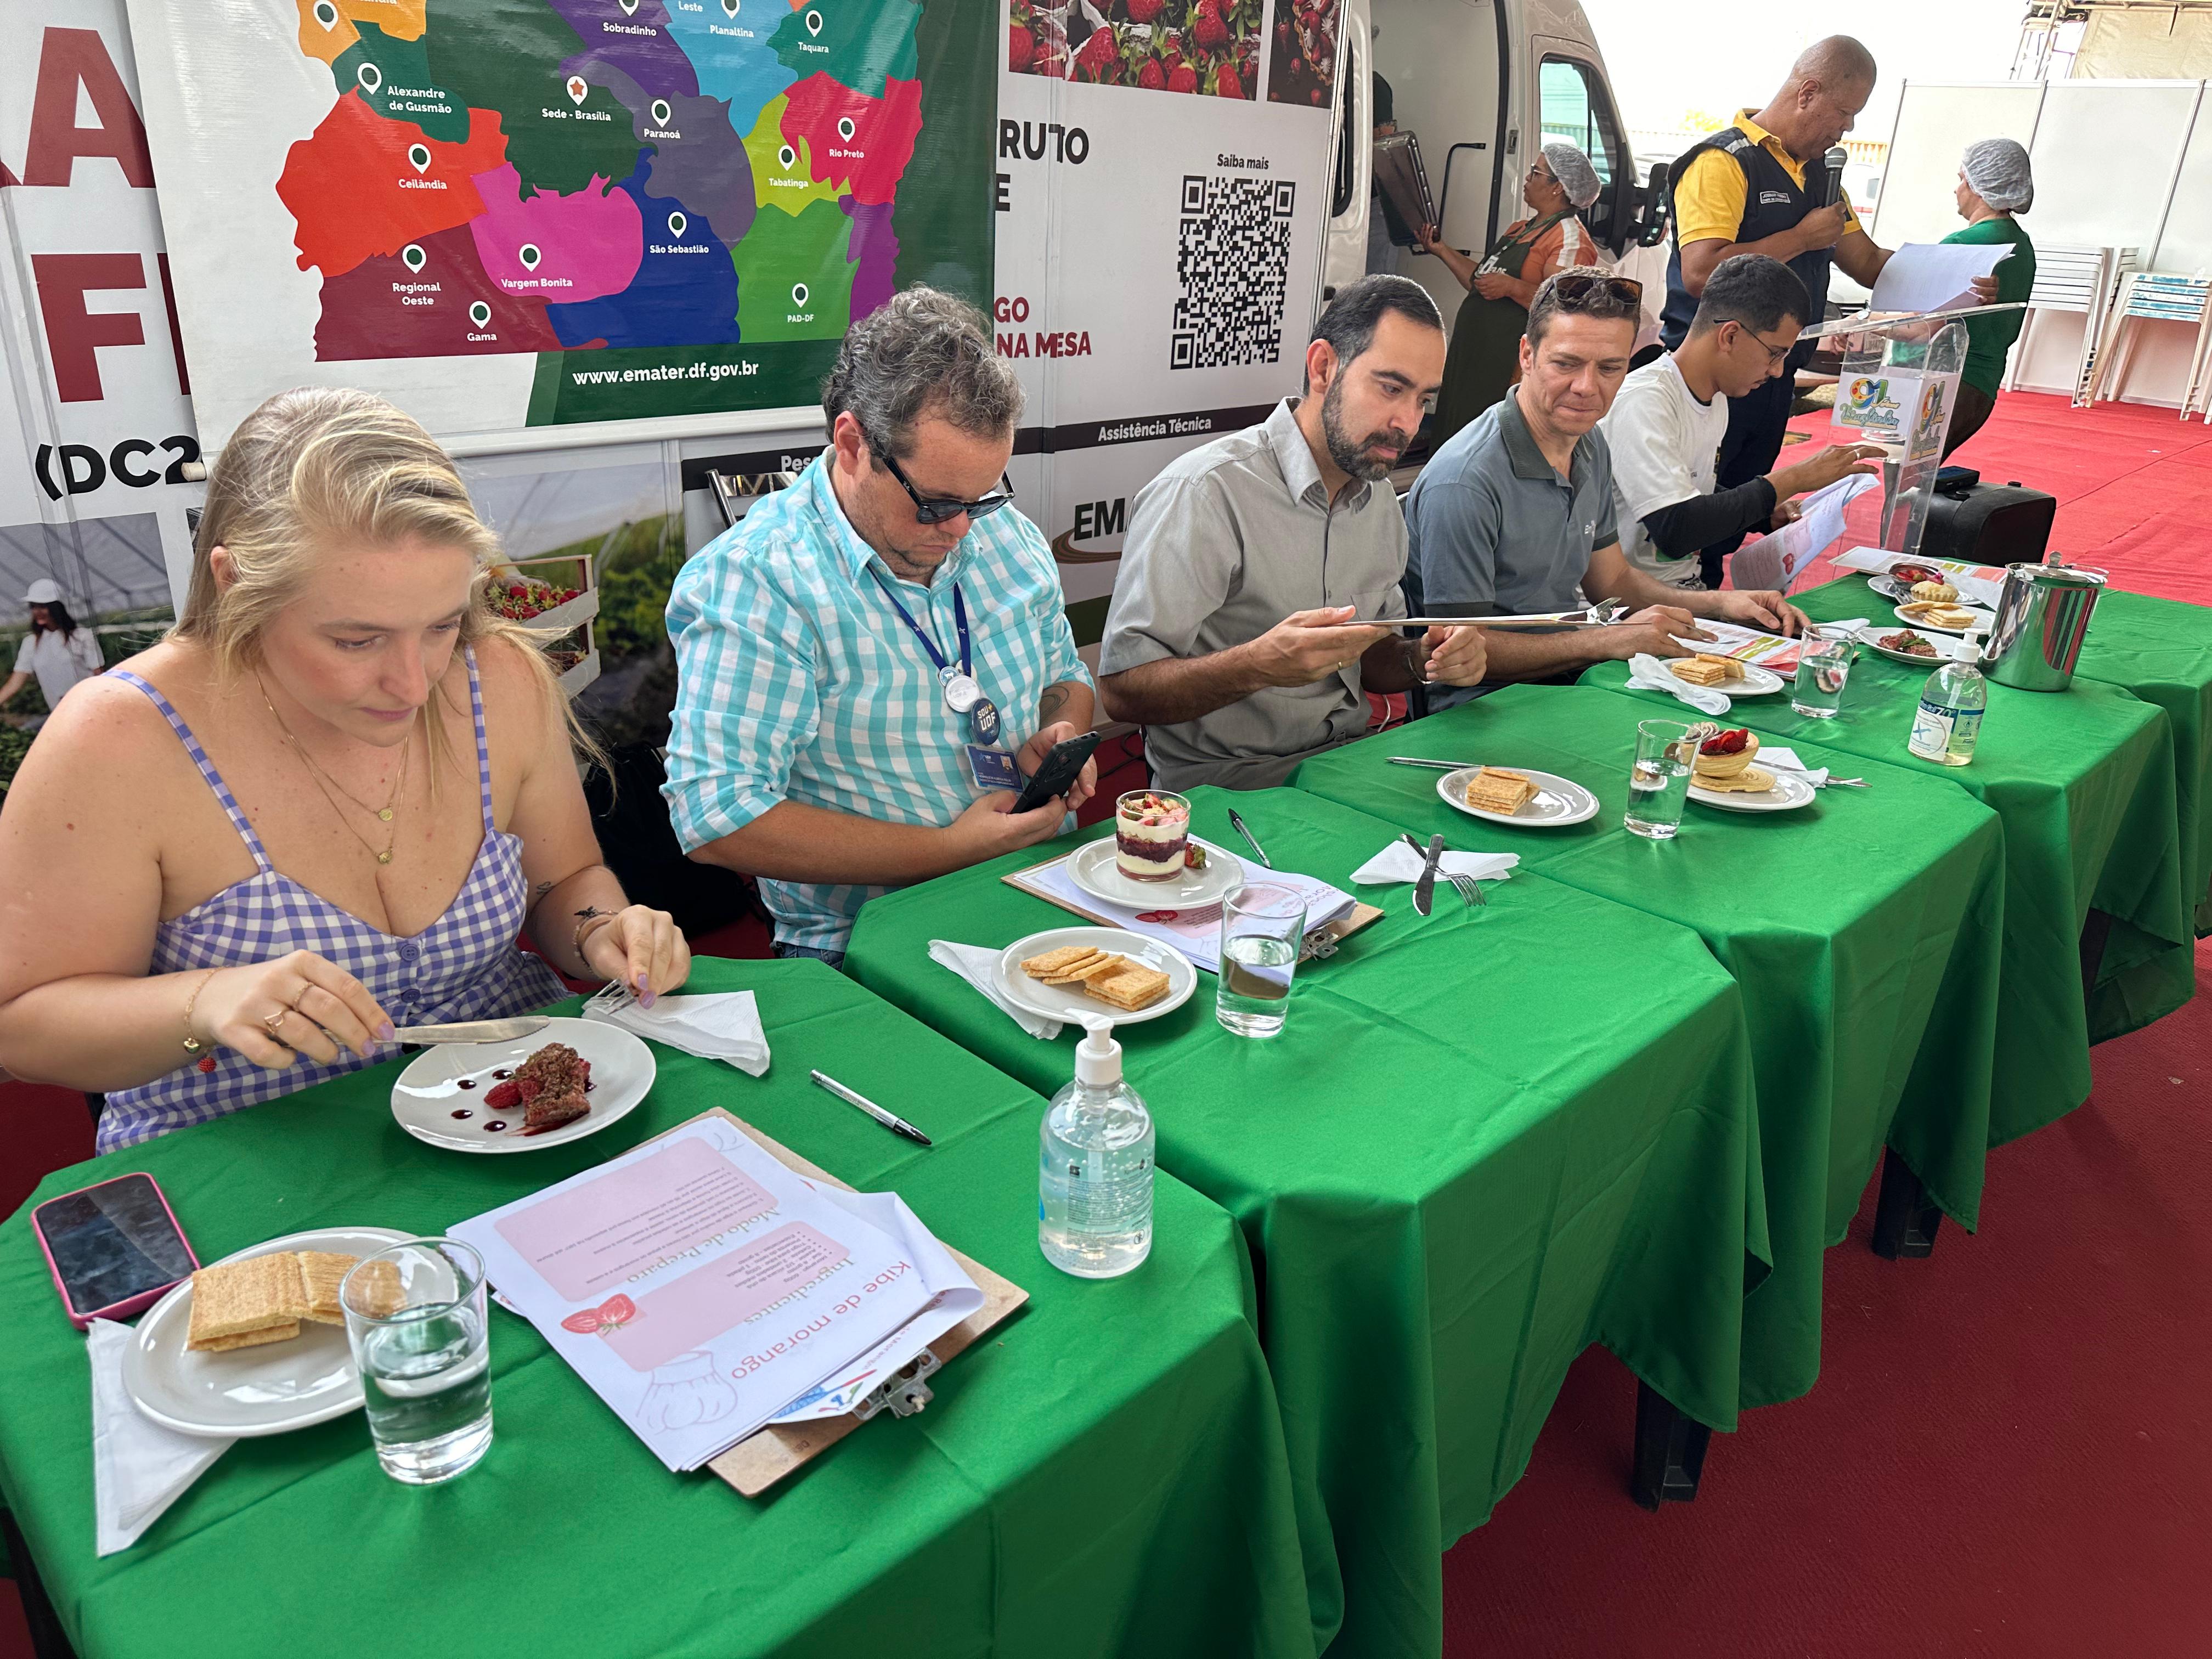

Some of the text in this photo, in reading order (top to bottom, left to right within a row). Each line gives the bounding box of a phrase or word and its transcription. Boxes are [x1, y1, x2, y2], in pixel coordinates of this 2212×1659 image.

[678, 1, 703, 12] Leste
[603, 22, 657, 36] Sobradinho
[710, 25, 754, 38] Planaltina
[798, 42, 829, 53] Taquara
[387, 86, 445, 99] Alexandre
[389, 101, 452, 114] de Gusmão
[542, 108, 567, 119] Sede
[575, 110, 611, 122] Brasília
[644, 128, 681, 139] Paranoá
[829, 149, 865, 159] Rio Preto
[1217, 154, 1269, 170] Saiba mais
[398, 179, 447, 190] Ceilândia
[769, 178, 809, 189] Tabatinga
[650, 245, 709, 253] São Sebastião
[392, 282, 441, 293] Regional
[501, 278, 573, 290] Vargem Bonita
[402, 296, 434, 306] Oeste
[787, 314, 814, 323] PAD-DF
[467, 332, 497, 341] Gama
[997, 331, 1092, 358] NA MESA
[572, 360, 759, 386] www.emater.df.gov.br
[1850, 378, 1888, 409] 91
[1098, 416, 1212, 441] Assistência Técnica
[980, 712, 996, 732] UDF
[727, 1207, 781, 1234] Modo
[702, 1233, 724, 1246] de
[627, 1246, 702, 1283] Preparo
[744, 1256, 855, 1324] Ingredientes
[732, 1261, 911, 1379] Kibe de morango
